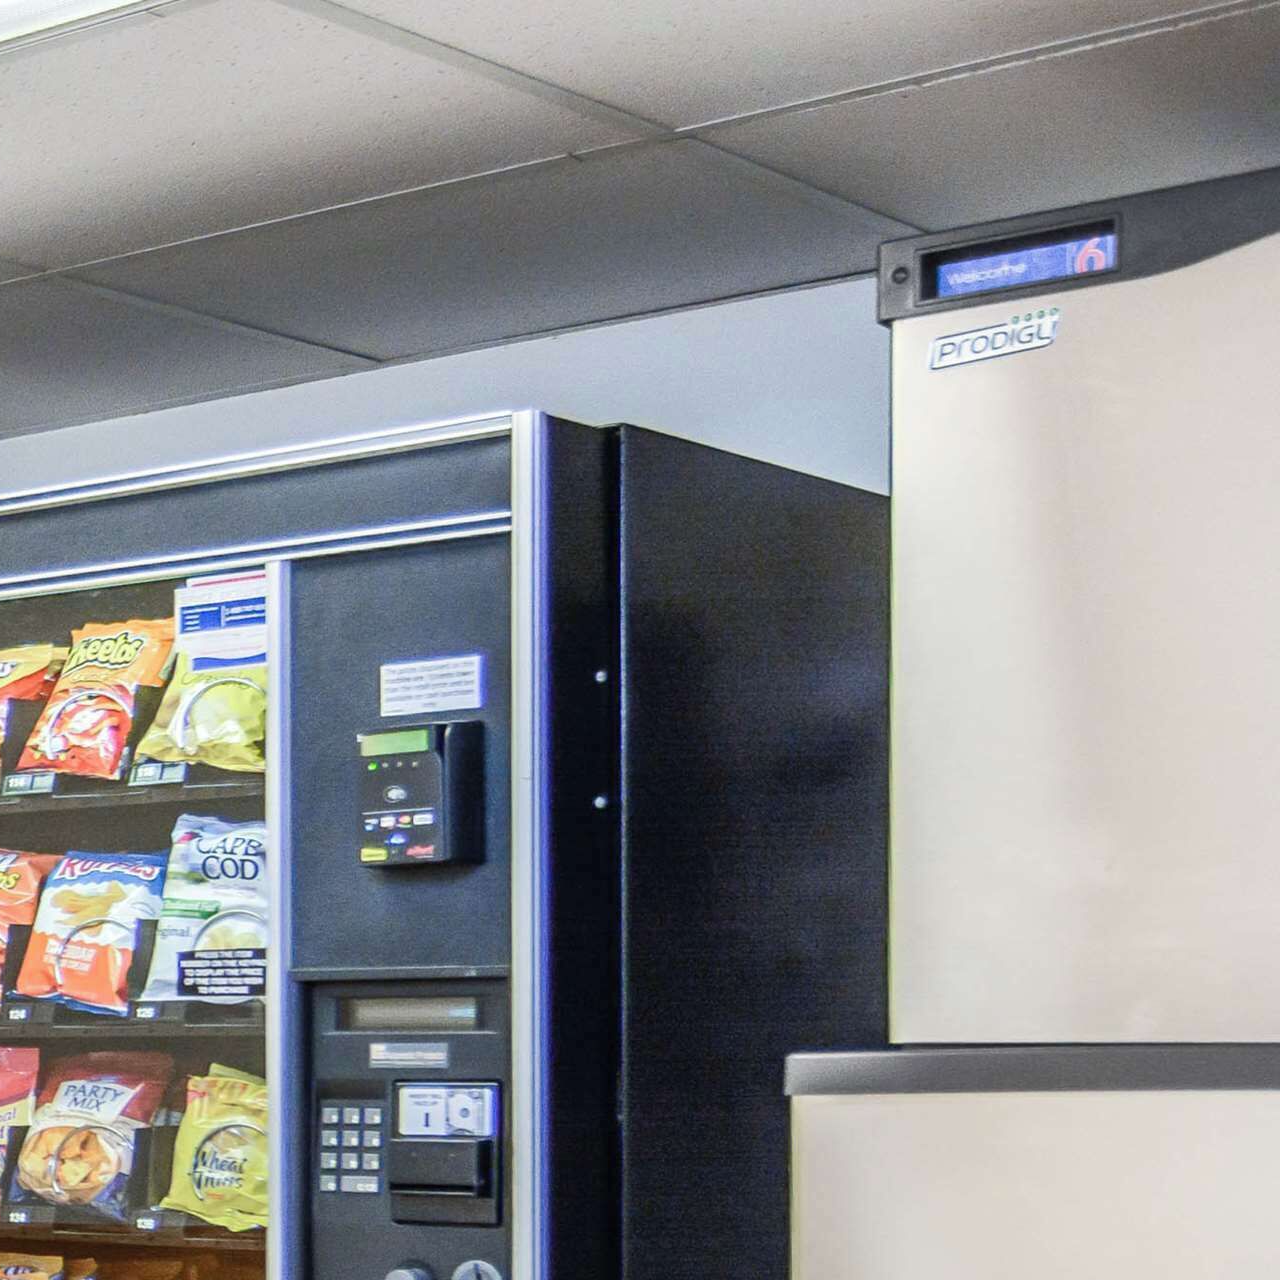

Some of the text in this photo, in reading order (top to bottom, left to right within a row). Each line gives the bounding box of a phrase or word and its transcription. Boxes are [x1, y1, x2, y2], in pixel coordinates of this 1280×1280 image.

[196, 837, 263, 856] CAPE
[201, 855, 259, 880] COD
[63, 1084, 125, 1102] PARTY
[68, 1097, 108, 1112] MIX
